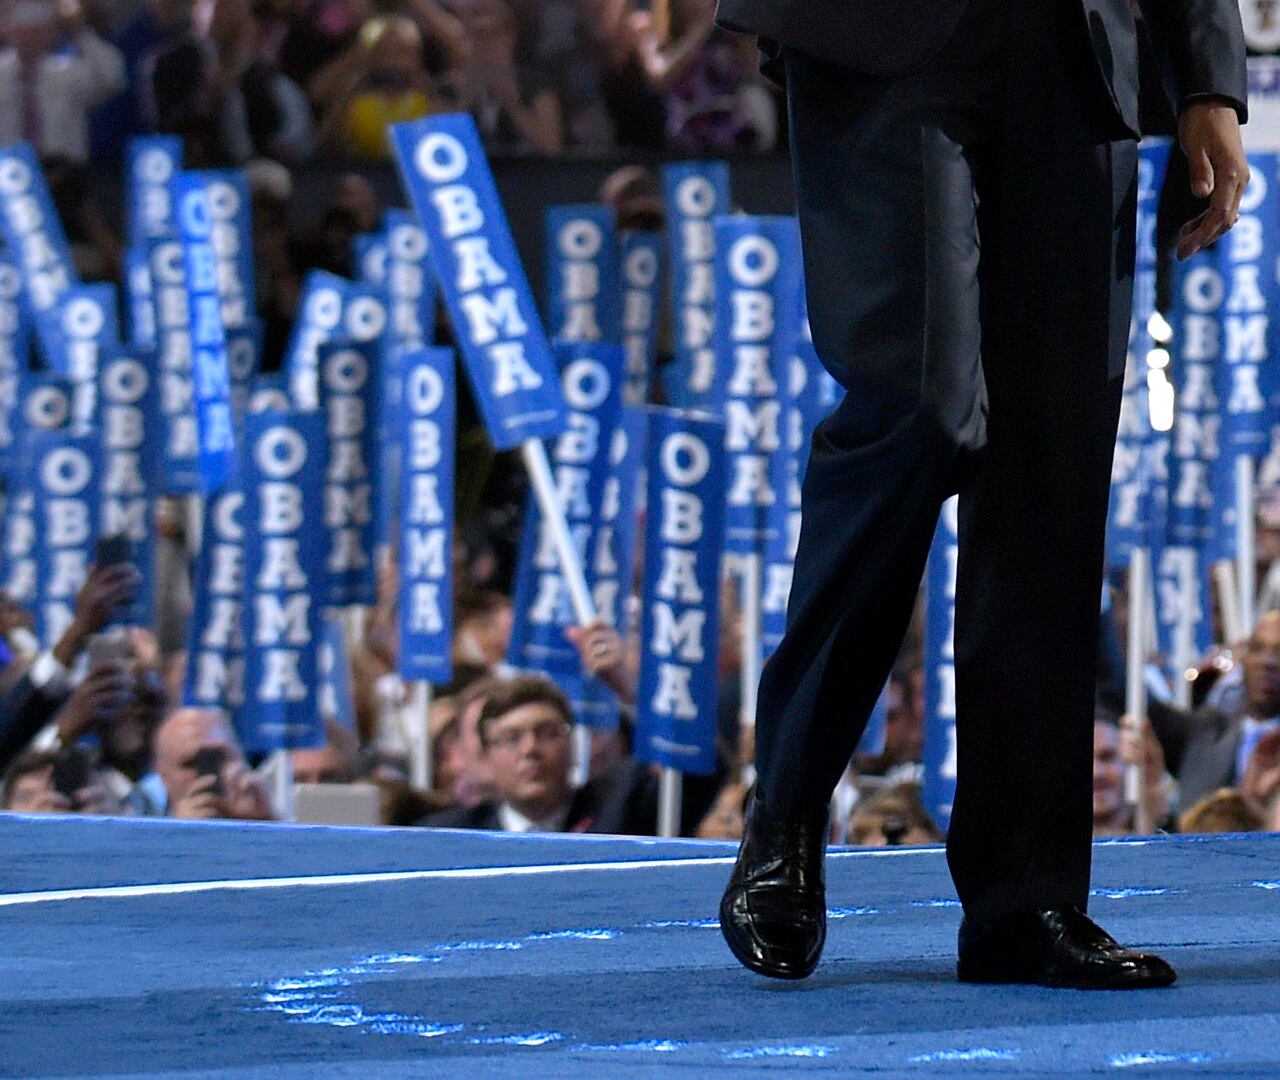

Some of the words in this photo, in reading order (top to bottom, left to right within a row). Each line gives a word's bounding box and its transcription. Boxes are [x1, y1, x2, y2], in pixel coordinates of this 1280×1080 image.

[414, 131, 544, 398] OBAMA
[557, 219, 603, 342] OBA
[725, 234, 781, 507] OBAMA
[103, 358, 148, 541] OBAM
[254, 427, 311, 703] OBAMA
[325, 348, 371, 572] OBAMA
[408, 364, 446, 632] OBAMA
[649, 432, 710, 720] OBAMA
